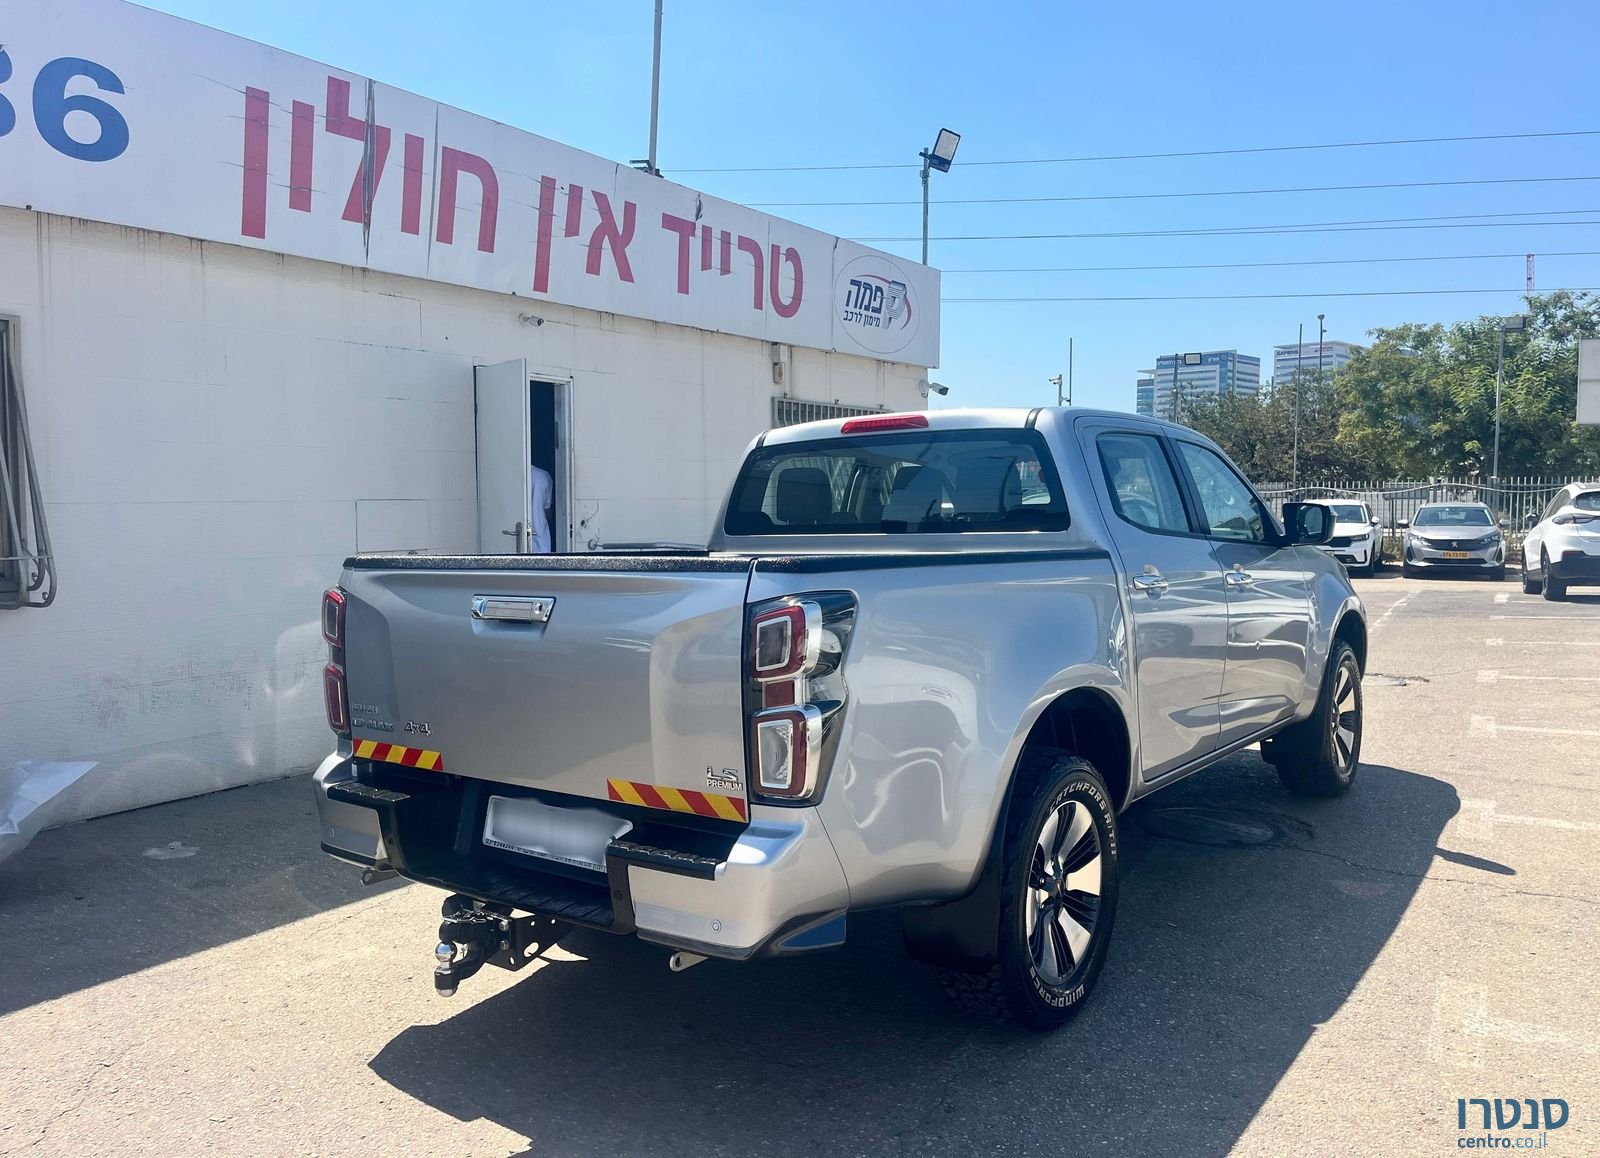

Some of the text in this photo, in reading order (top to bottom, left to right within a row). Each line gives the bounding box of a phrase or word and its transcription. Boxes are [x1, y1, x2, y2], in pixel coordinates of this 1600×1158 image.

[0, 46, 130, 163] 6
[240, 75, 804, 319] טרייד אין חולון
[843, 311, 880, 327] מימון לרכב
[706, 766, 739, 782] LS
[706, 779, 744, 791] PREMIUM
[1048, 781, 1107, 816] CATCHFORS
